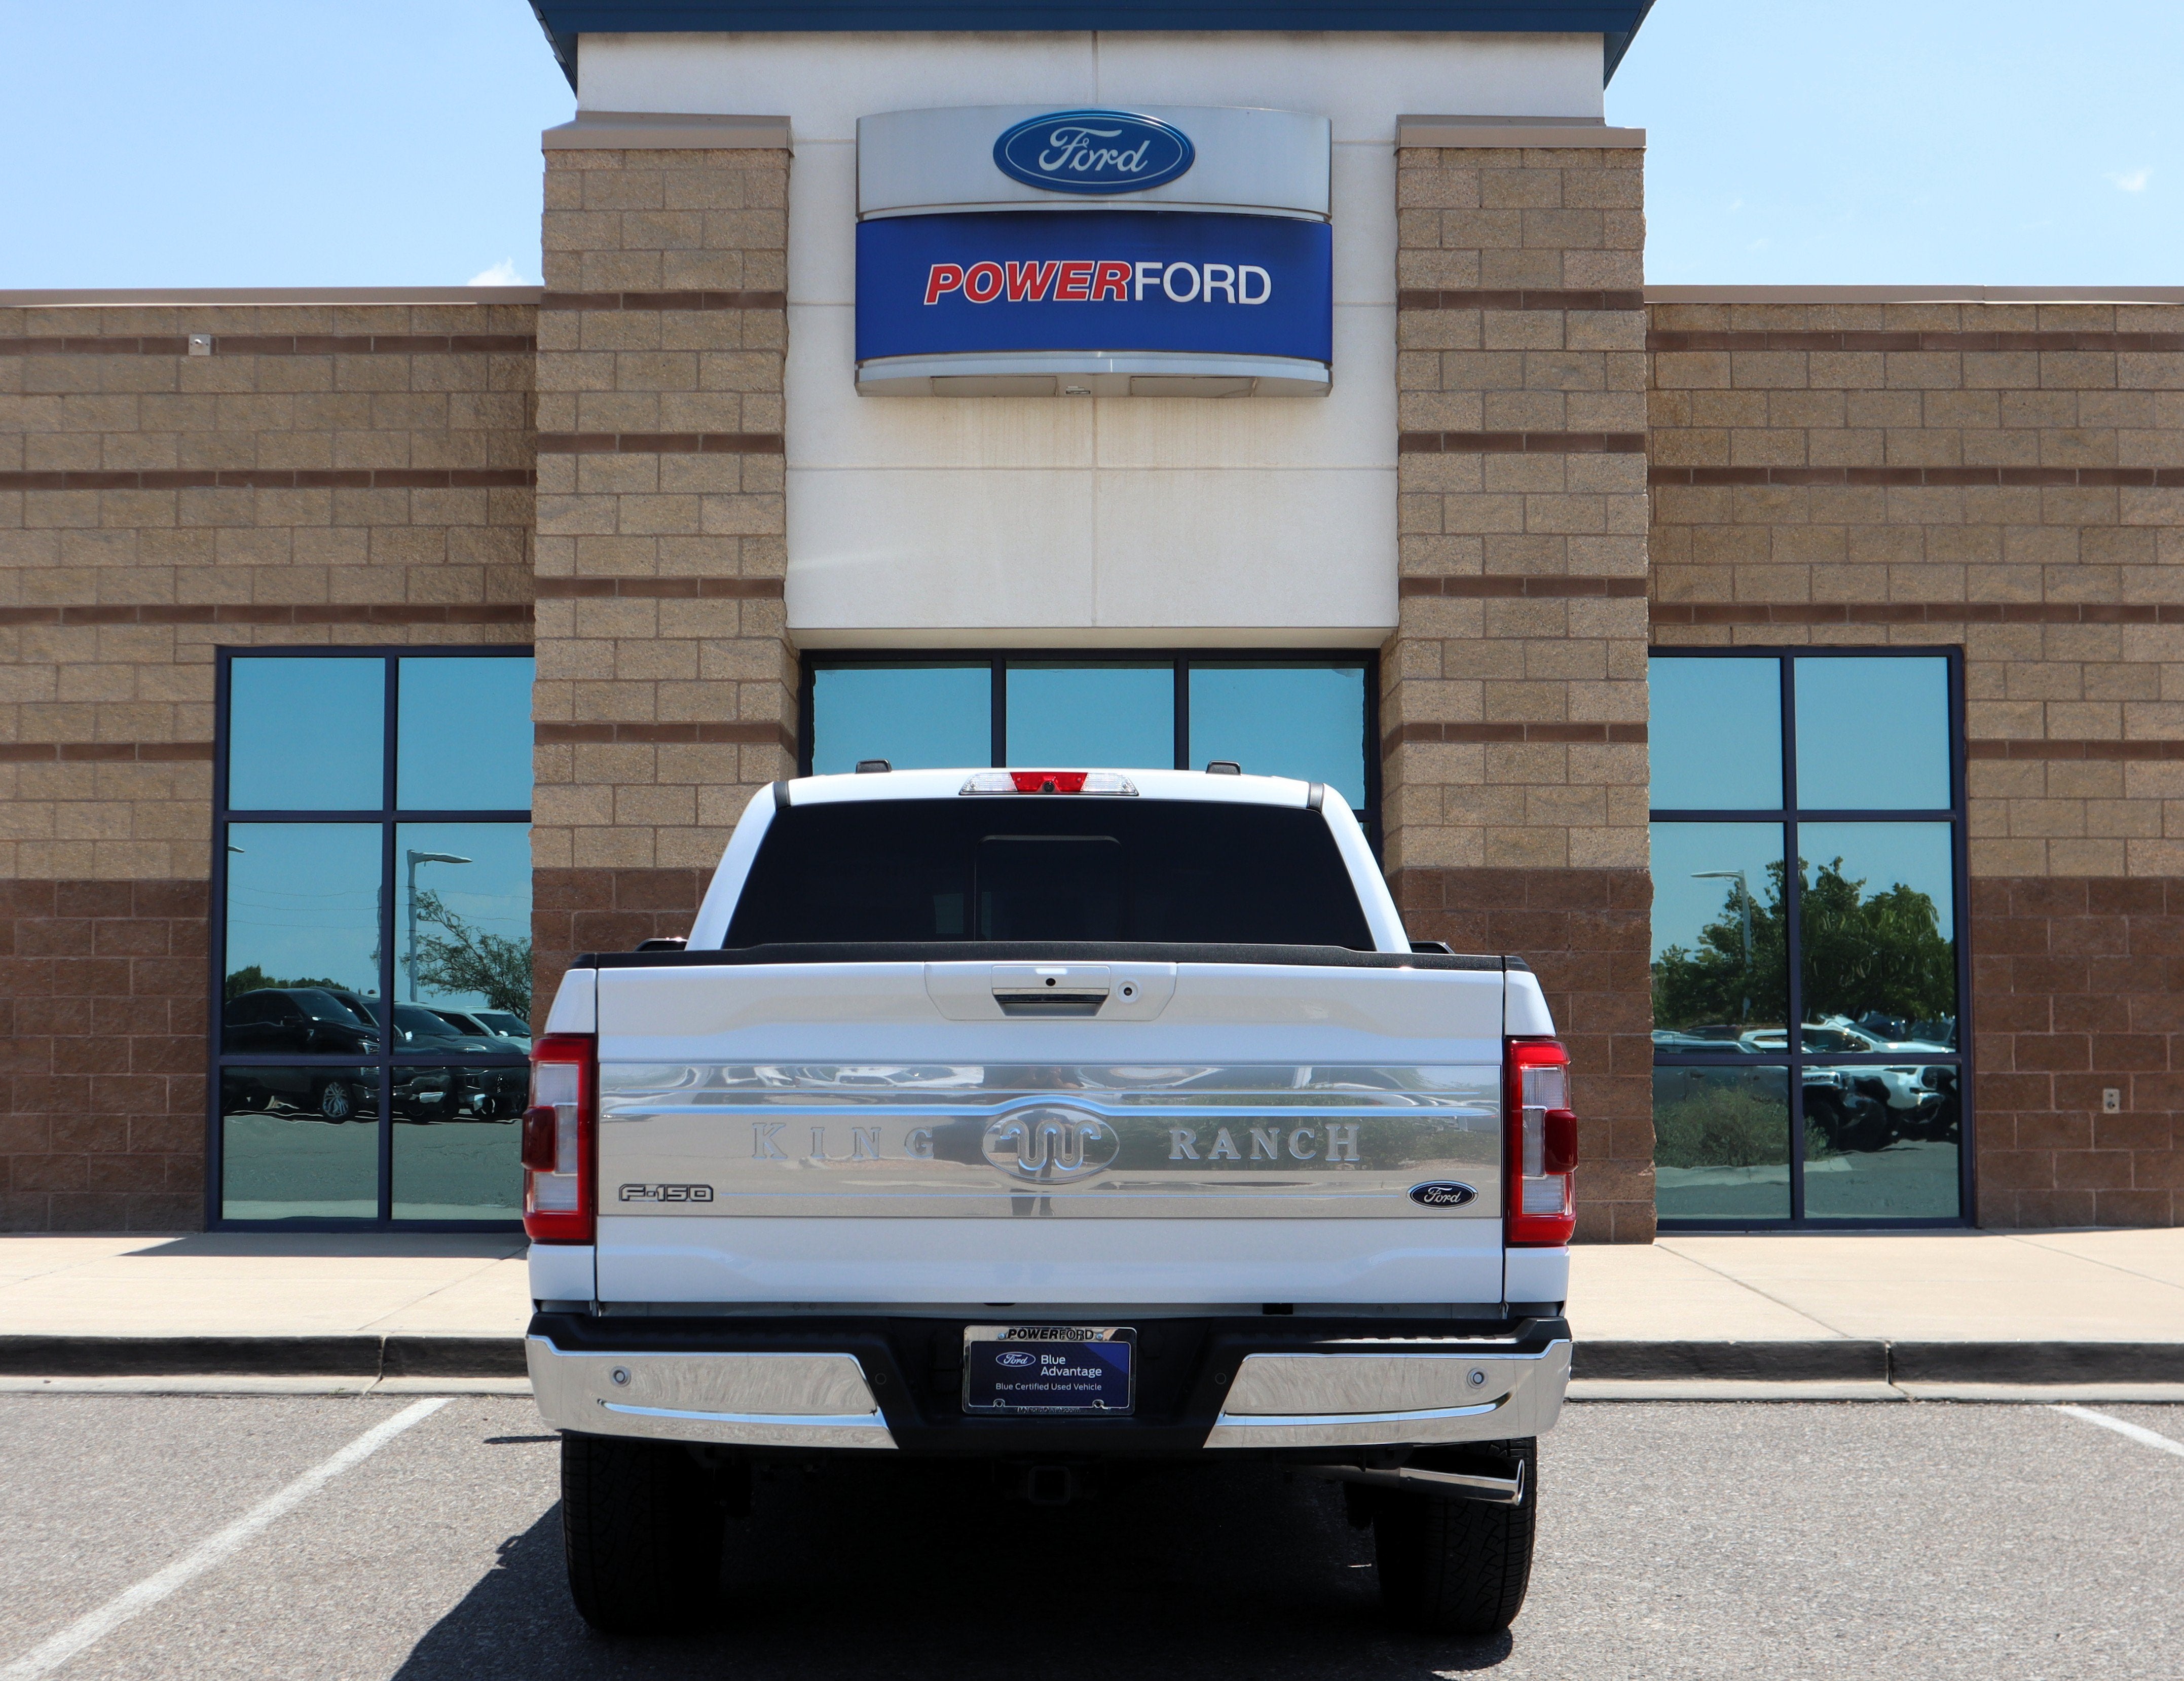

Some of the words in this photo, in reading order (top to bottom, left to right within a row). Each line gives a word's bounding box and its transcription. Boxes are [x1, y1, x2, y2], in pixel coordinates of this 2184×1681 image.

[1039, 126, 1150, 173] Ford
[923, 260, 1272, 305] POWERFORD
[752, 1122, 935, 1159] KING
[1168, 1123, 1361, 1162] RANCH
[618, 1183, 714, 1202] F-150
[1423, 1186, 1462, 1205] Ford
[1003, 1354, 1028, 1365] Ford
[1041, 1355, 1066, 1365] Blue
[1040, 1366, 1102, 1378] Advantage
[1015, 1382, 1049, 1391] Certified
[1074, 1383, 1102, 1391] Vehicle
